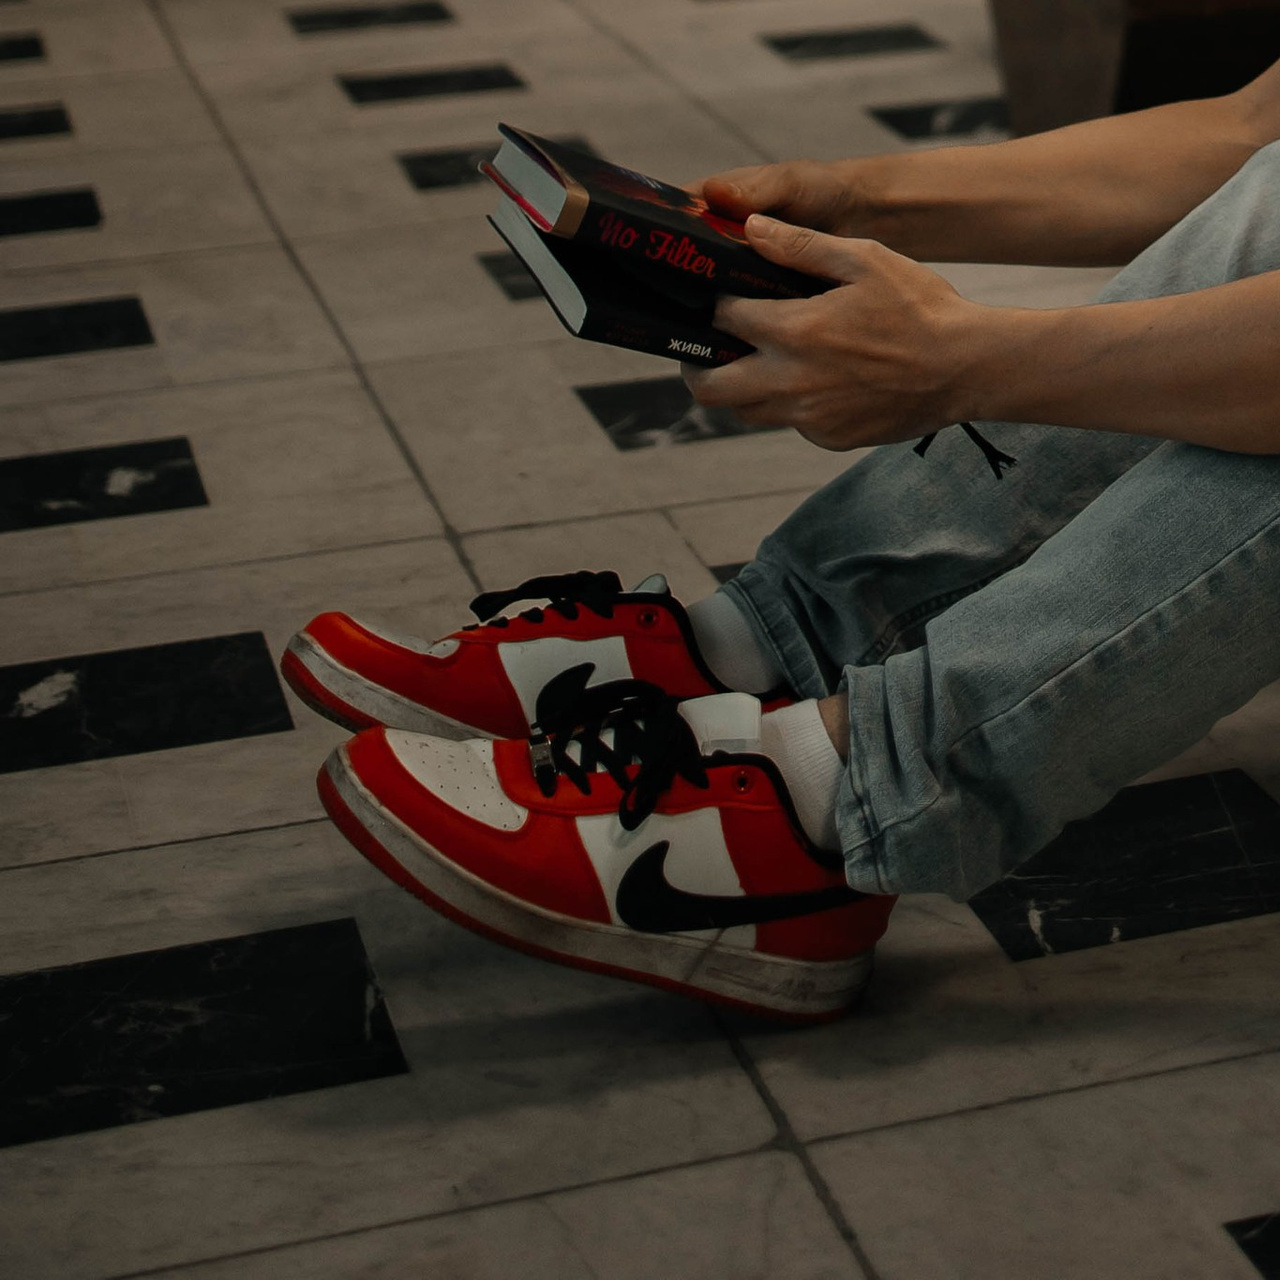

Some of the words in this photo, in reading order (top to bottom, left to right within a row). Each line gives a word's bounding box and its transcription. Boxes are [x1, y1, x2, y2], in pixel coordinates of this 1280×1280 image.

[600, 211, 641, 250] No
[645, 228, 719, 281] Filter
[666, 337, 714, 360] ЖИВИ.
